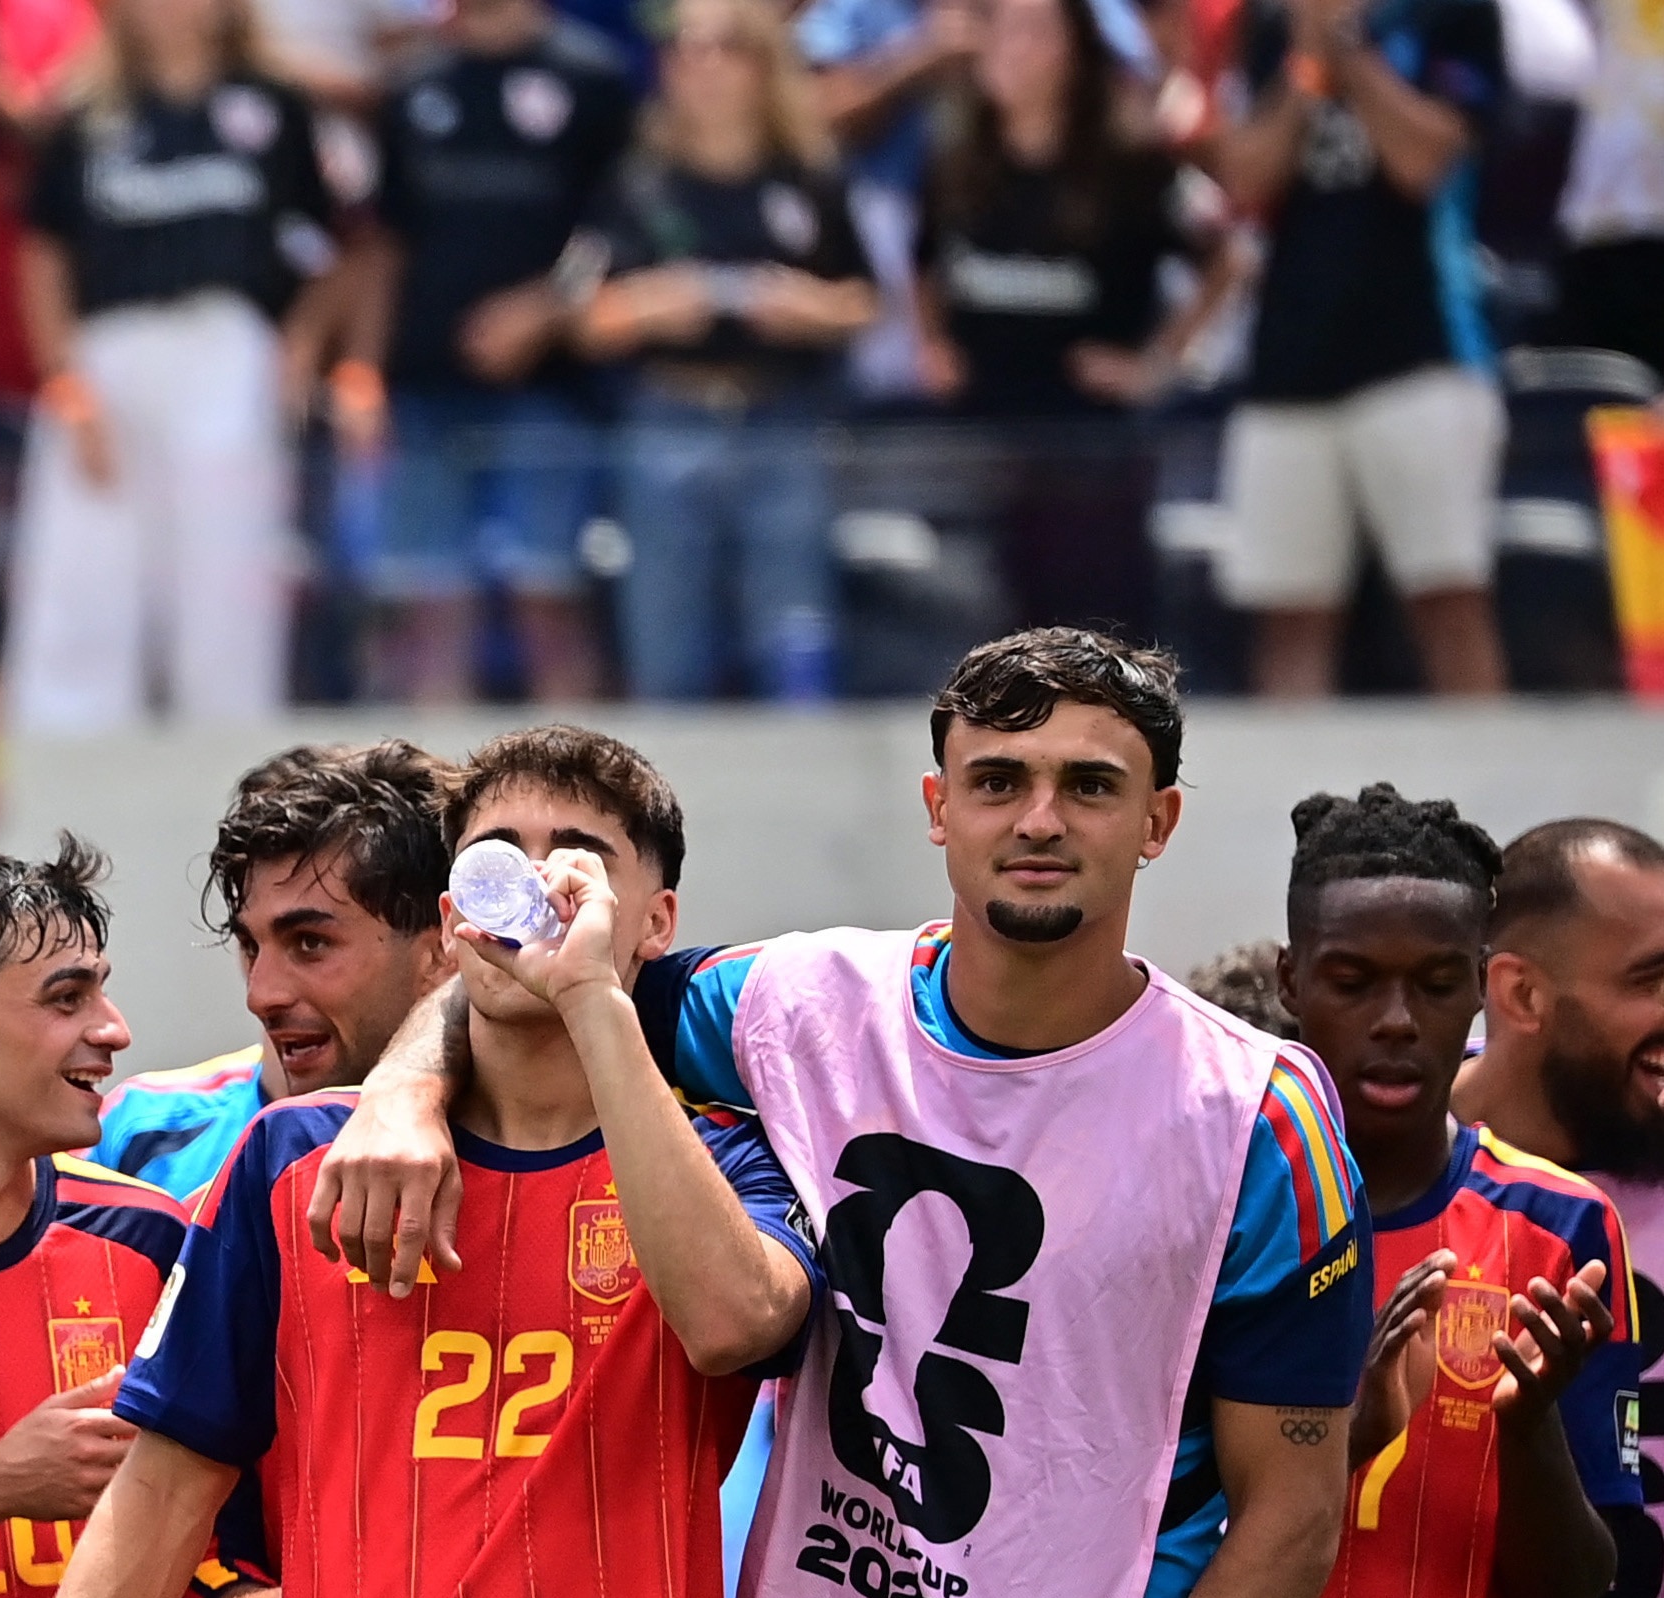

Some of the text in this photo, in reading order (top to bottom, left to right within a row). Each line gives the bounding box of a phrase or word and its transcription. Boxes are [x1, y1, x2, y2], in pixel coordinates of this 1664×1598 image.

[1309, 1237, 1359, 1300] ESPAÑ
[413, 1330, 574, 1460] 22
[1359, 1430, 1408, 1528] 7
